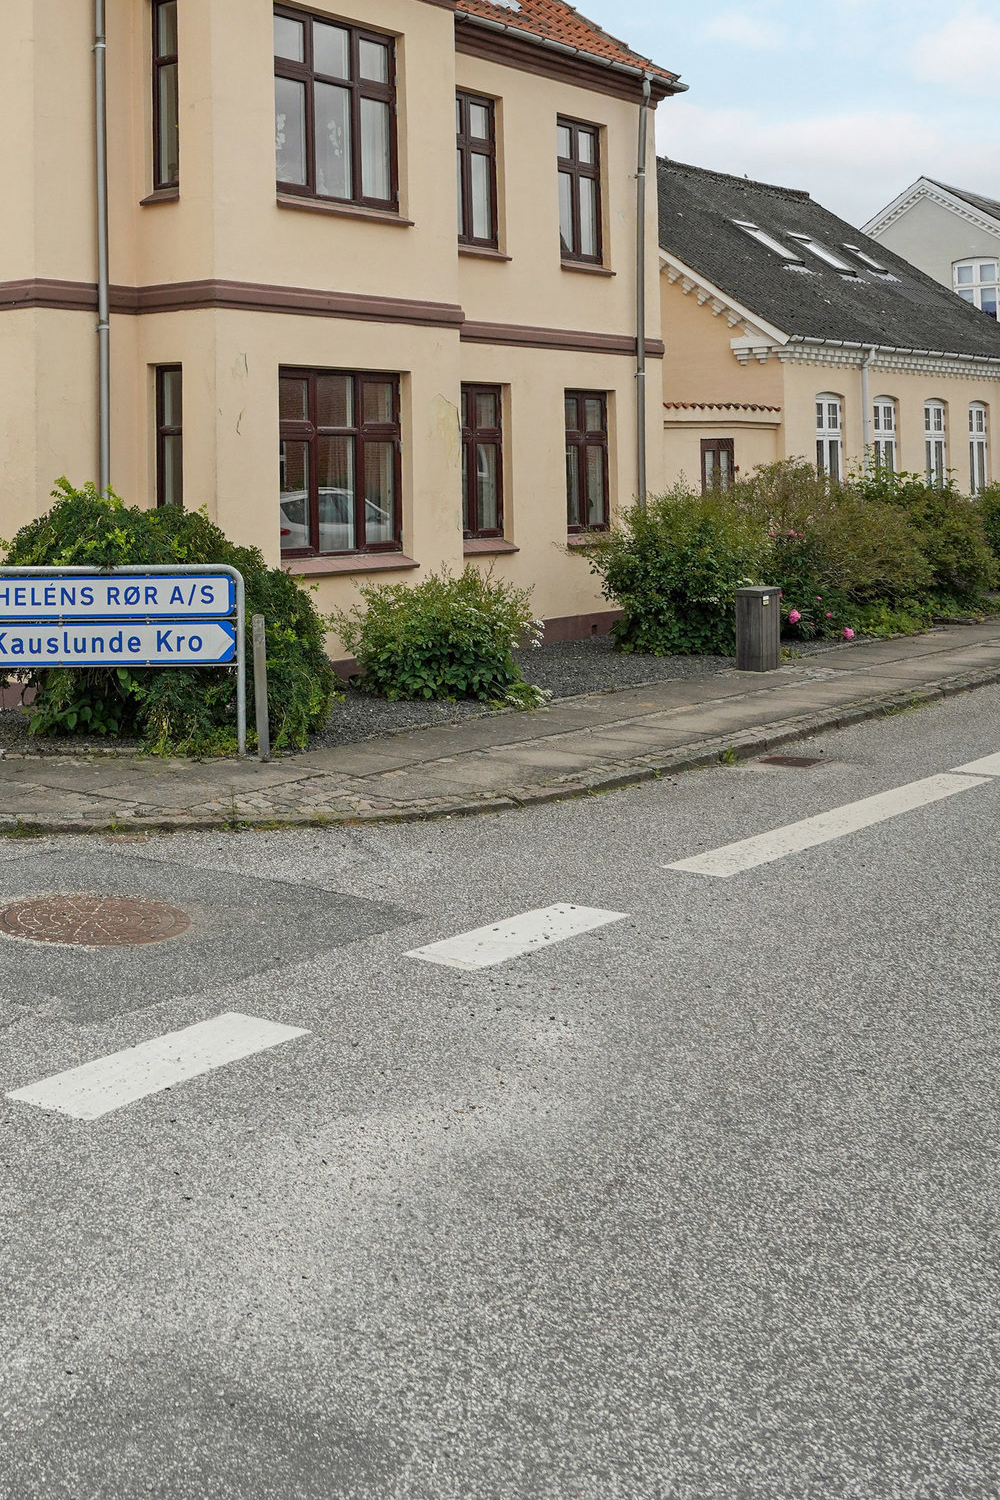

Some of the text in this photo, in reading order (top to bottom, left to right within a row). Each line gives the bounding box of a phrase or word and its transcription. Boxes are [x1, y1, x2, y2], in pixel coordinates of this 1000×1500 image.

[106, 585, 158, 606] RØR
[169, 583, 215, 607] A/S
[156, 630, 203, 653] Kro
